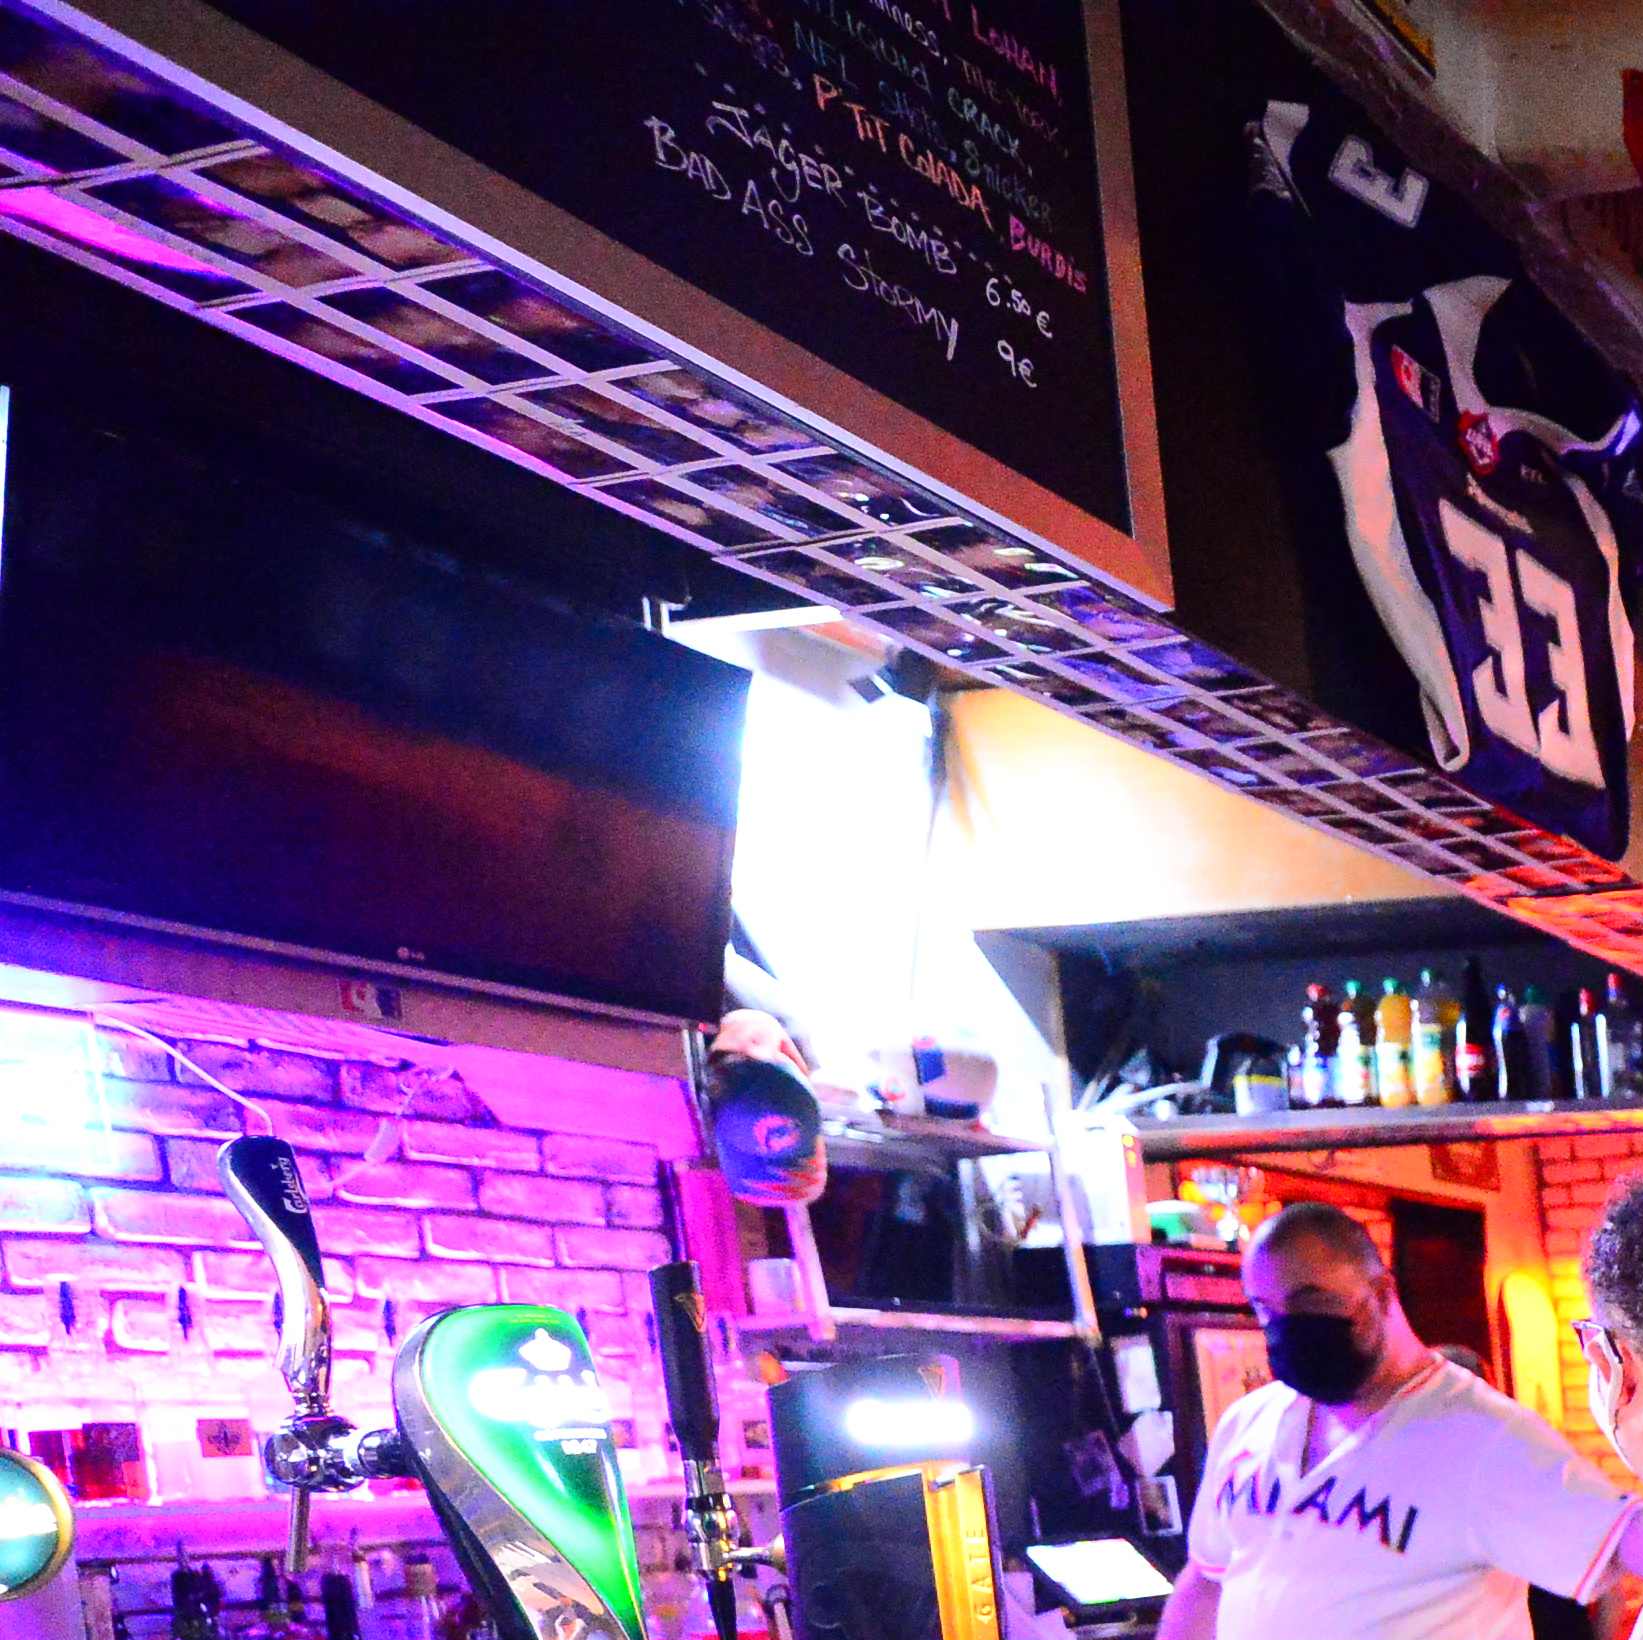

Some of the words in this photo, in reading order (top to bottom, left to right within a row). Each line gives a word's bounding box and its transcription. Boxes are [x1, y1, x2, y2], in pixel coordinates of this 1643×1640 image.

[643, 114, 733, 201] BAD
[740, 178, 814, 257] ASS
[858, 188, 958, 275] BOMB
[1439, 498, 1608, 789] 33
[1216, 1458, 1419, 1555] MIAMI
